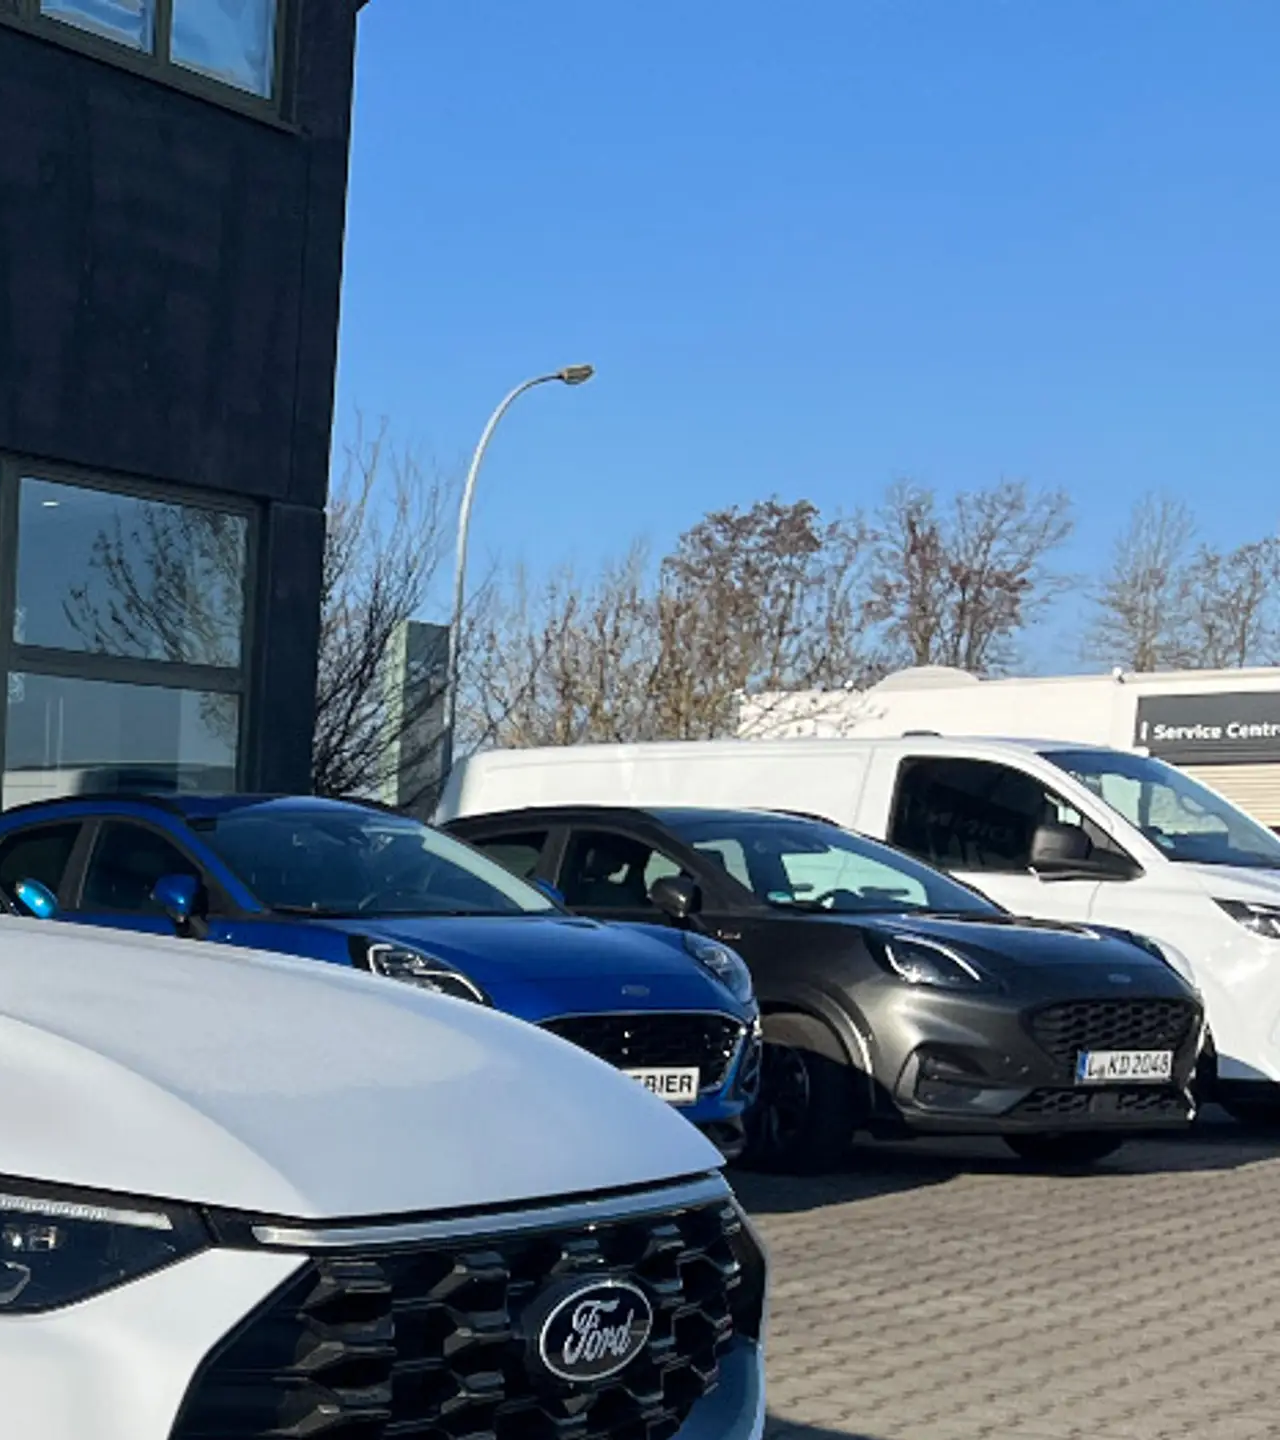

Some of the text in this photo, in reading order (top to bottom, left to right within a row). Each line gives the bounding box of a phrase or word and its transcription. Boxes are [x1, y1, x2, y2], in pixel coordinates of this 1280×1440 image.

[1153, 721, 1280, 740] Service Centr
[562, 1298, 635, 1365] Ford
